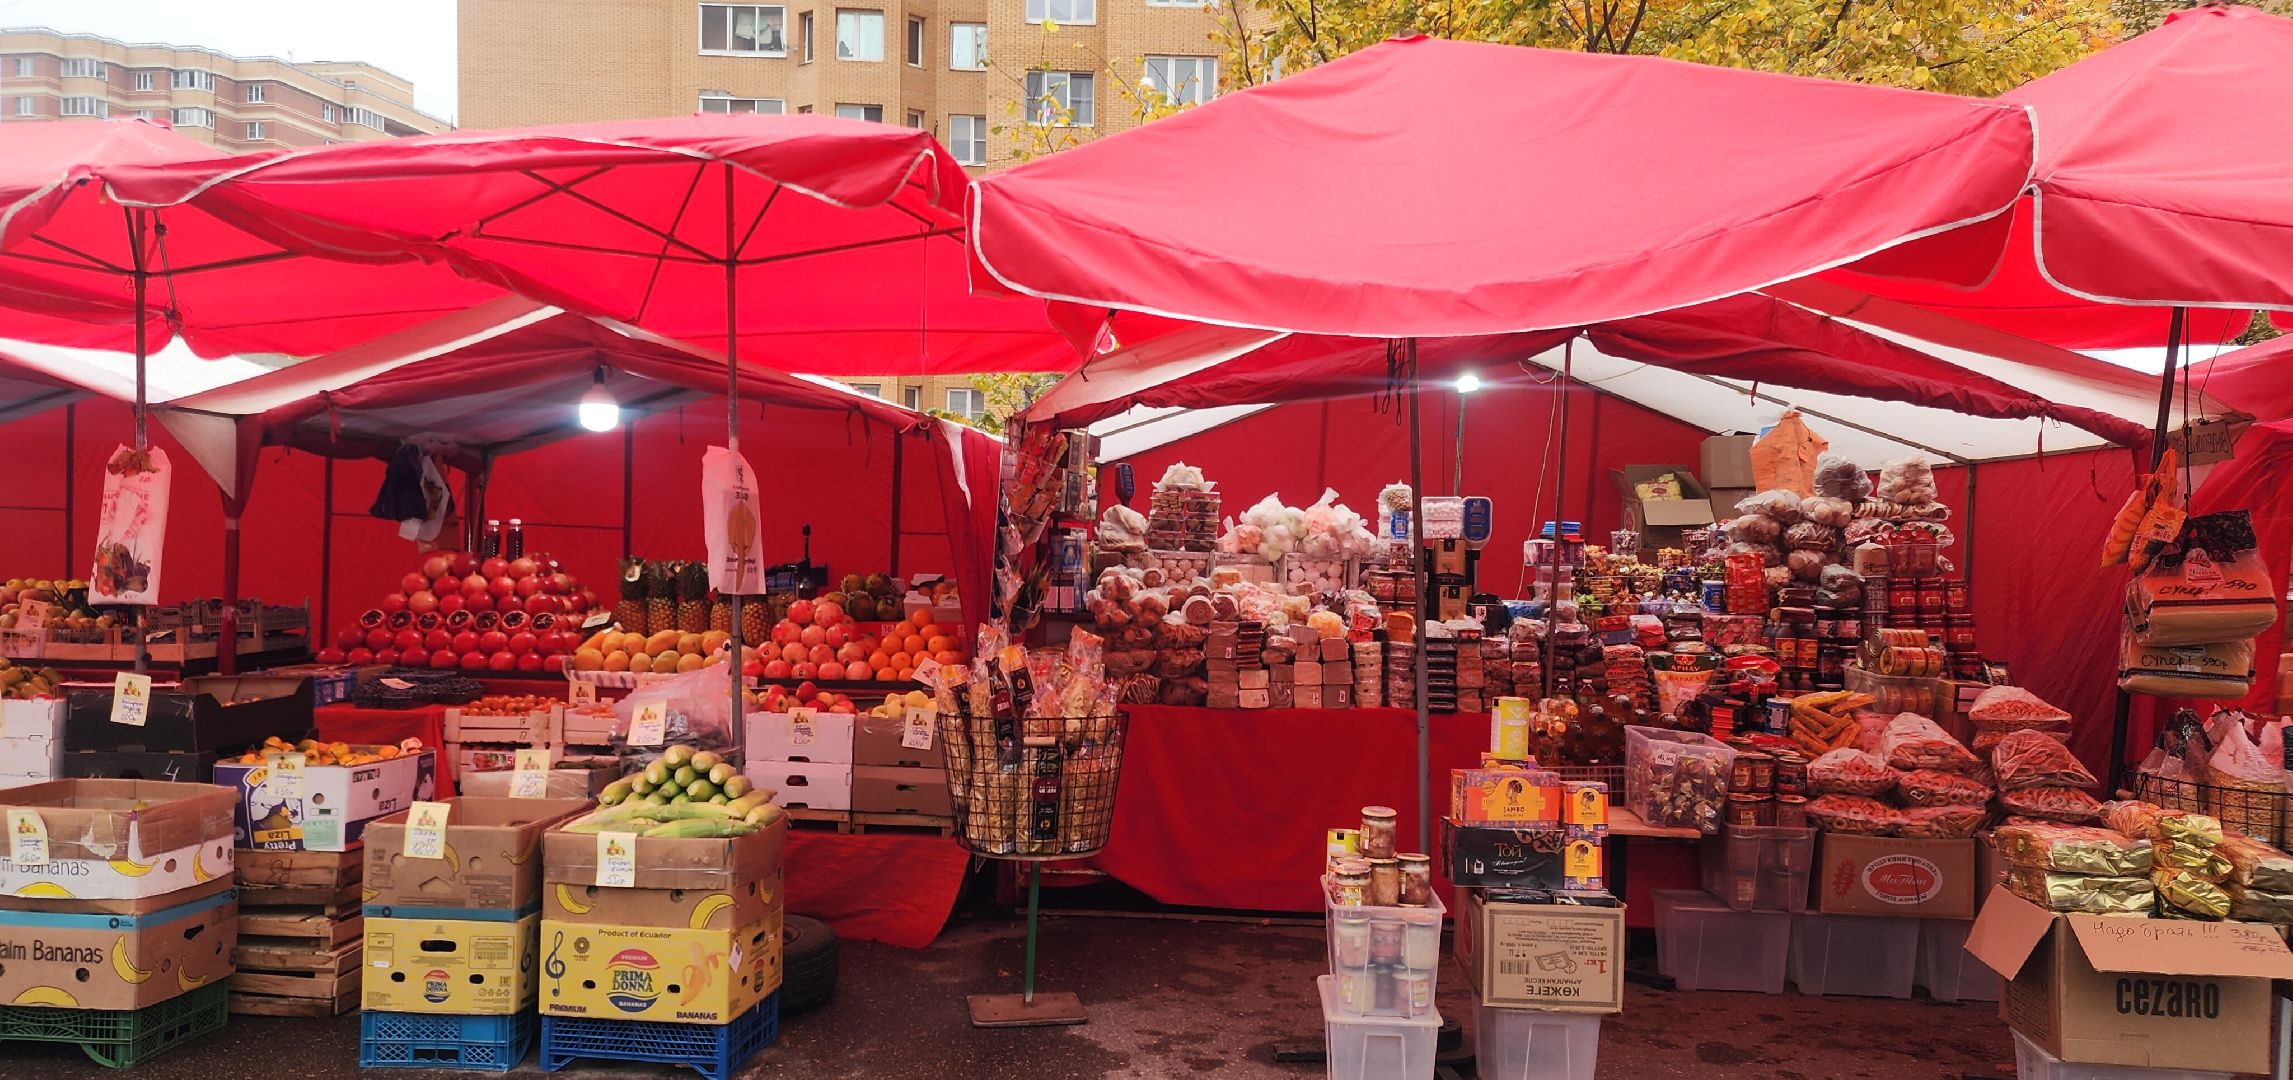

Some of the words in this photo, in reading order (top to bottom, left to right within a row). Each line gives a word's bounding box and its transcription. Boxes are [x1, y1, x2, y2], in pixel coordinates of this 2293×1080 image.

[379, 798, 397, 812] Liza
[268, 830, 290, 840] Liza
[264, 841, 296, 851] Pretty
[1493, 842, 1522, 857] Той
[598, 929, 628, 938] Product
[640, 931, 671, 939] Ecuador
[0, 940, 26, 960] alm
[33, 939, 104, 964] Bananas
[613, 970, 653, 982] PRIMA
[612, 981, 654, 992] DONNA
[1526, 984, 1580, 997] КӨЖЕГЕ
[549, 1003, 587, 1013] PREMIUM
[676, 1011, 718, 1020] BANANAS
